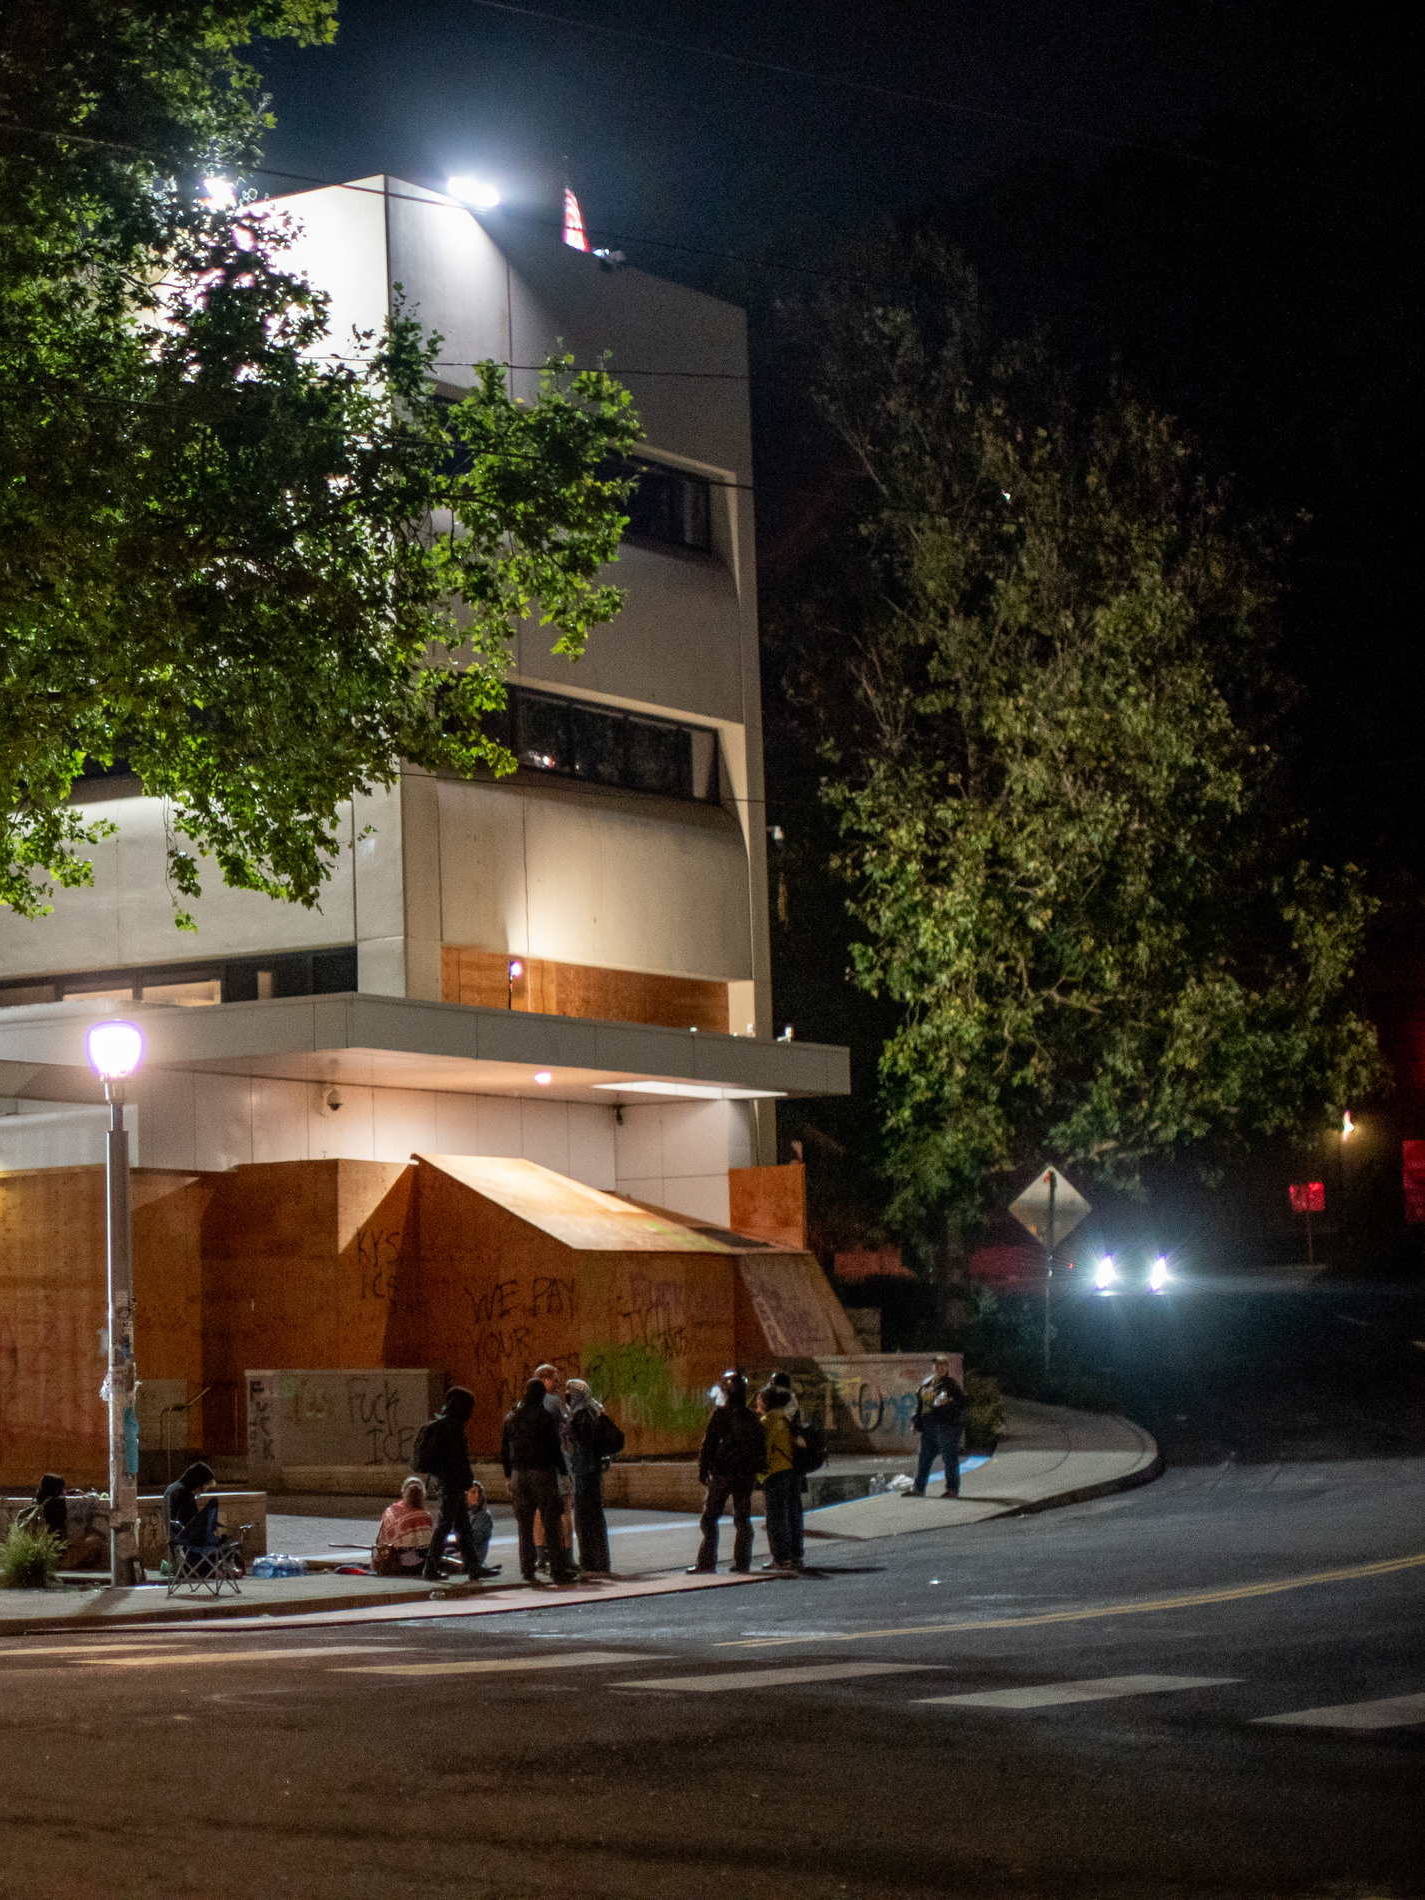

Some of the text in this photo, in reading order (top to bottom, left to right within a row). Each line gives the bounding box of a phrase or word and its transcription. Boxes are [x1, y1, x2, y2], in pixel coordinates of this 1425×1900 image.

[356, 1228, 401, 1268] KYS
[462, 1279, 518, 1325] WE
[531, 1276, 577, 1322] PAY
[364, 1426, 416, 1466] ICE
